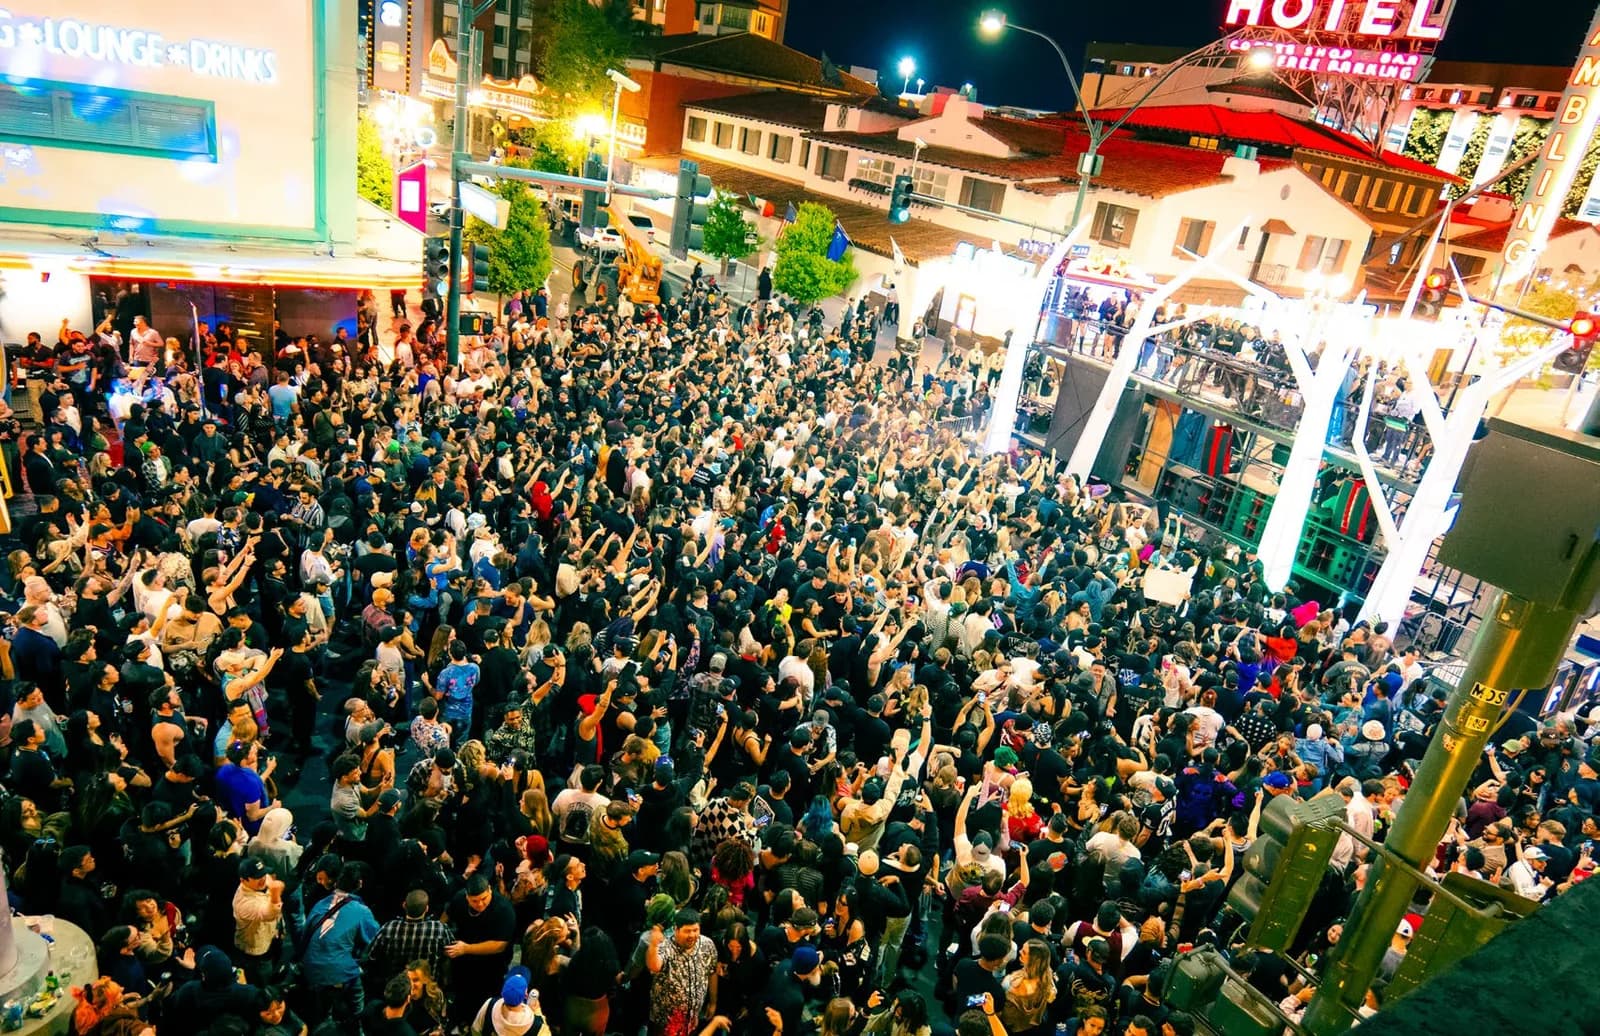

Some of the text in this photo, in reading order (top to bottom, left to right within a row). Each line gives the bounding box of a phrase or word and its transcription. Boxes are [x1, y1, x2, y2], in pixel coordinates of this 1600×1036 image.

[1225, 0, 1442, 38] HOTEL
[44, 18, 163, 68] LOUNGE
[189, 39, 276, 83] DRINKS
[1304, 46, 1353, 59] SHOP
[1380, 52, 1418, 65] BAR
[1276, 55, 1412, 80] FREE PARKING
